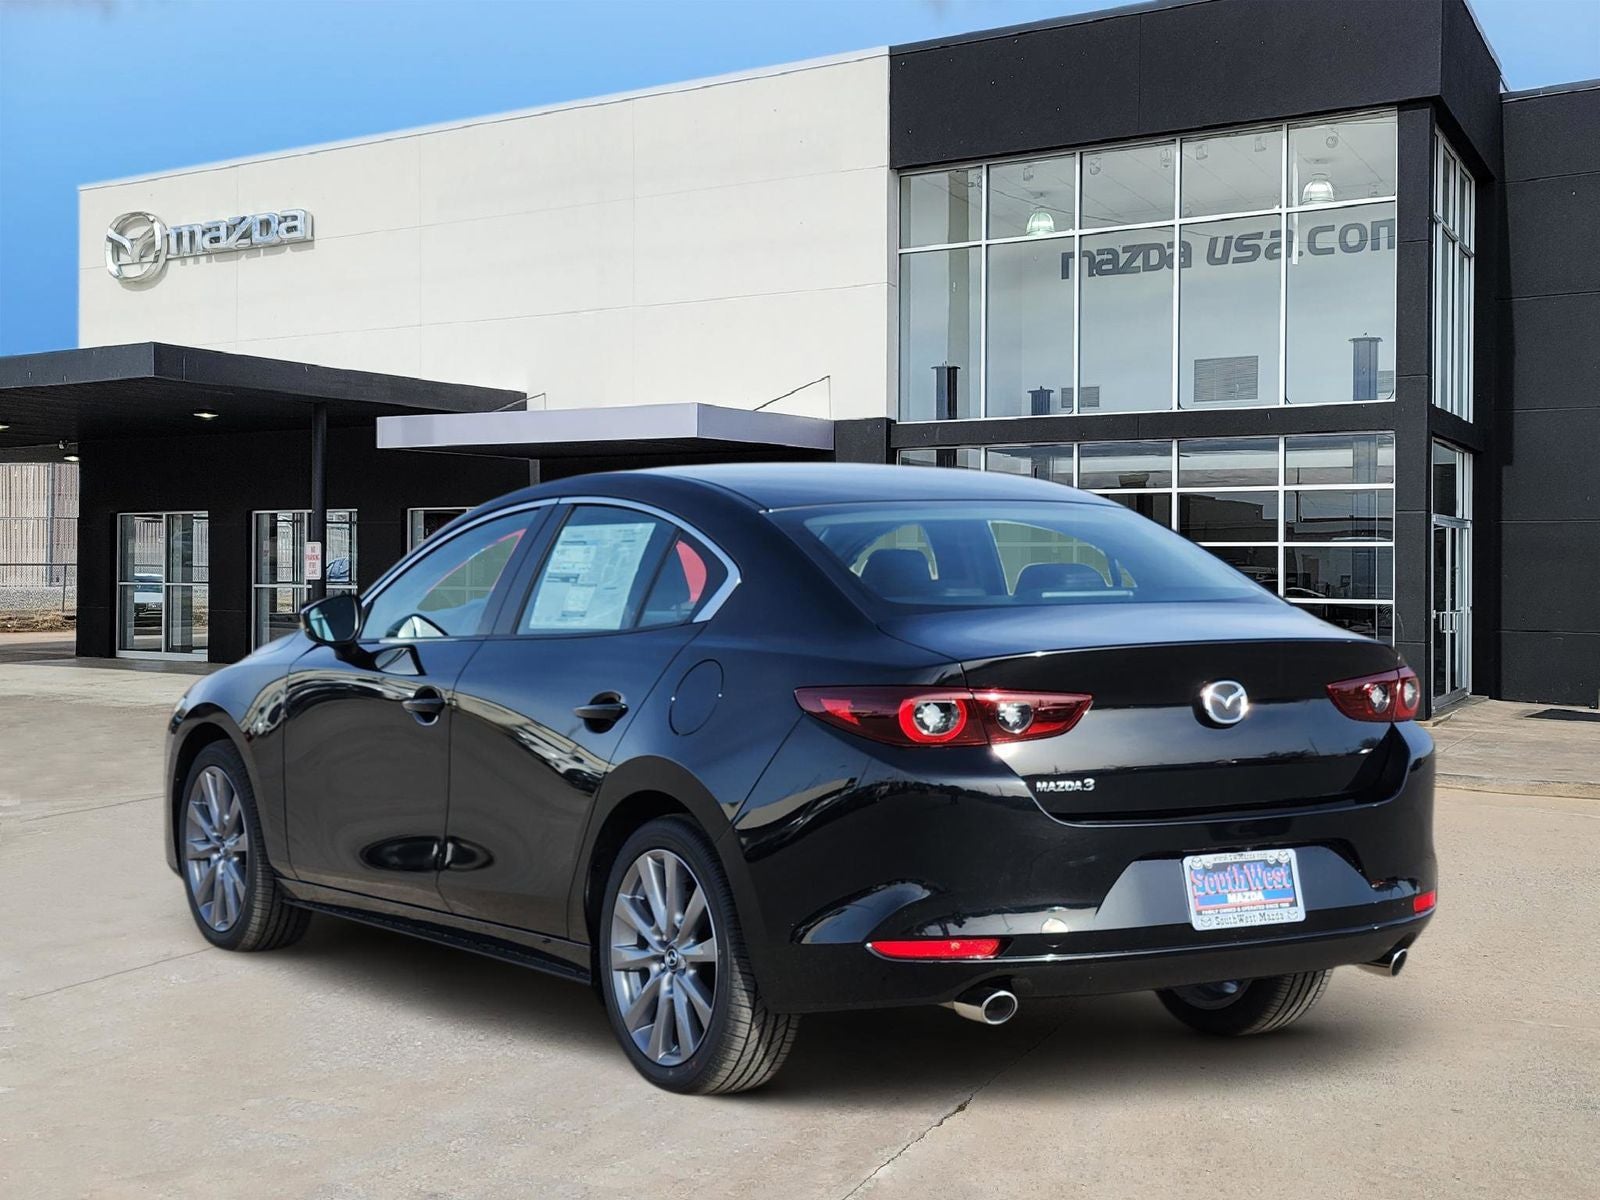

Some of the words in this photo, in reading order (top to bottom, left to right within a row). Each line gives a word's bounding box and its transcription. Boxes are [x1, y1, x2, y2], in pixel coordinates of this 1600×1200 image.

[167, 208, 313, 257] mazda
[1061, 240, 1192, 280] mazda
[1190, 861, 1293, 895] SouthWest
[1258, 911, 1285, 922] Mazda
